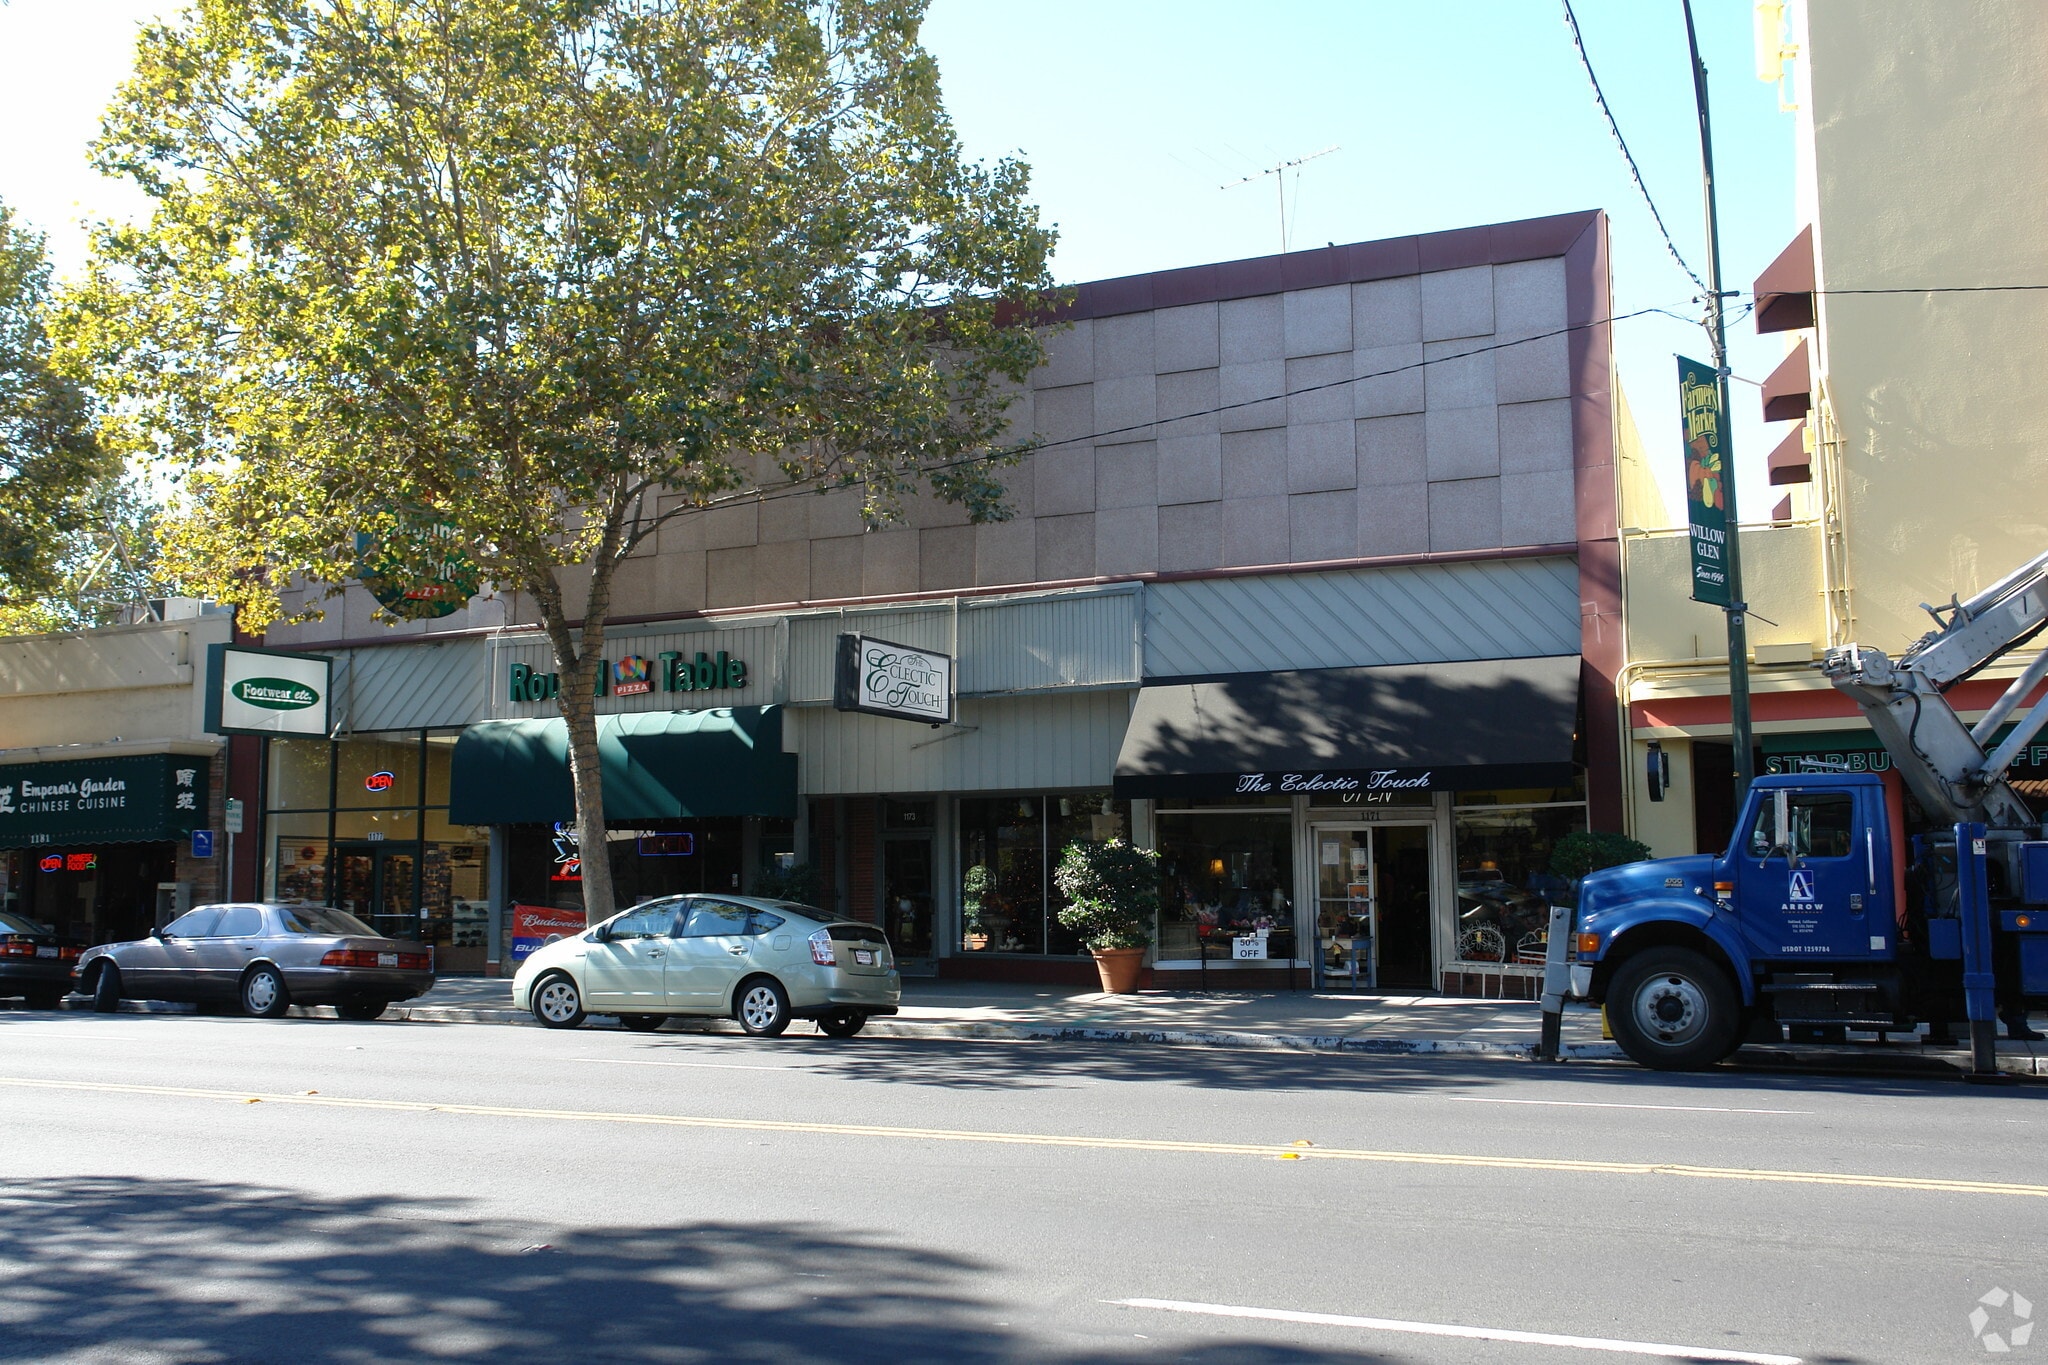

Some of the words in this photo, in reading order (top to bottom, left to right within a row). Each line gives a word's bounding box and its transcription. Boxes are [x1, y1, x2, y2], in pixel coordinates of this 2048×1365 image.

[1687, 406, 1718, 442] Market
[1690, 523, 1725, 544] WILLOW
[1697, 542, 1719, 560] GLEN
[659, 651, 747, 692] Table
[242, 683, 291, 699] Footwear
[294, 689, 312, 700] etc.
[617, 683, 648, 693] PIZZA
[22, 780, 78, 799] Emperor's
[80, 777, 125, 798] Garden
[365, 775, 393, 788] OPEN
[1236, 773, 1271, 793] The
[1280, 773, 1359, 791] Eclectic
[1367, 769, 1431, 789] Touch
[20, 800, 70, 813] CHINESE
[77, 796, 125, 810] CUISINE
[904, 812, 916, 820] 1173
[1361, 812, 1381, 821] 1171
[30, 834, 50, 844] 1181
[368, 832, 384, 841] 1177
[40, 858, 62, 870] OPEN
[67, 853, 93, 863] CHINESE
[67, 862, 86, 871] FOOD
